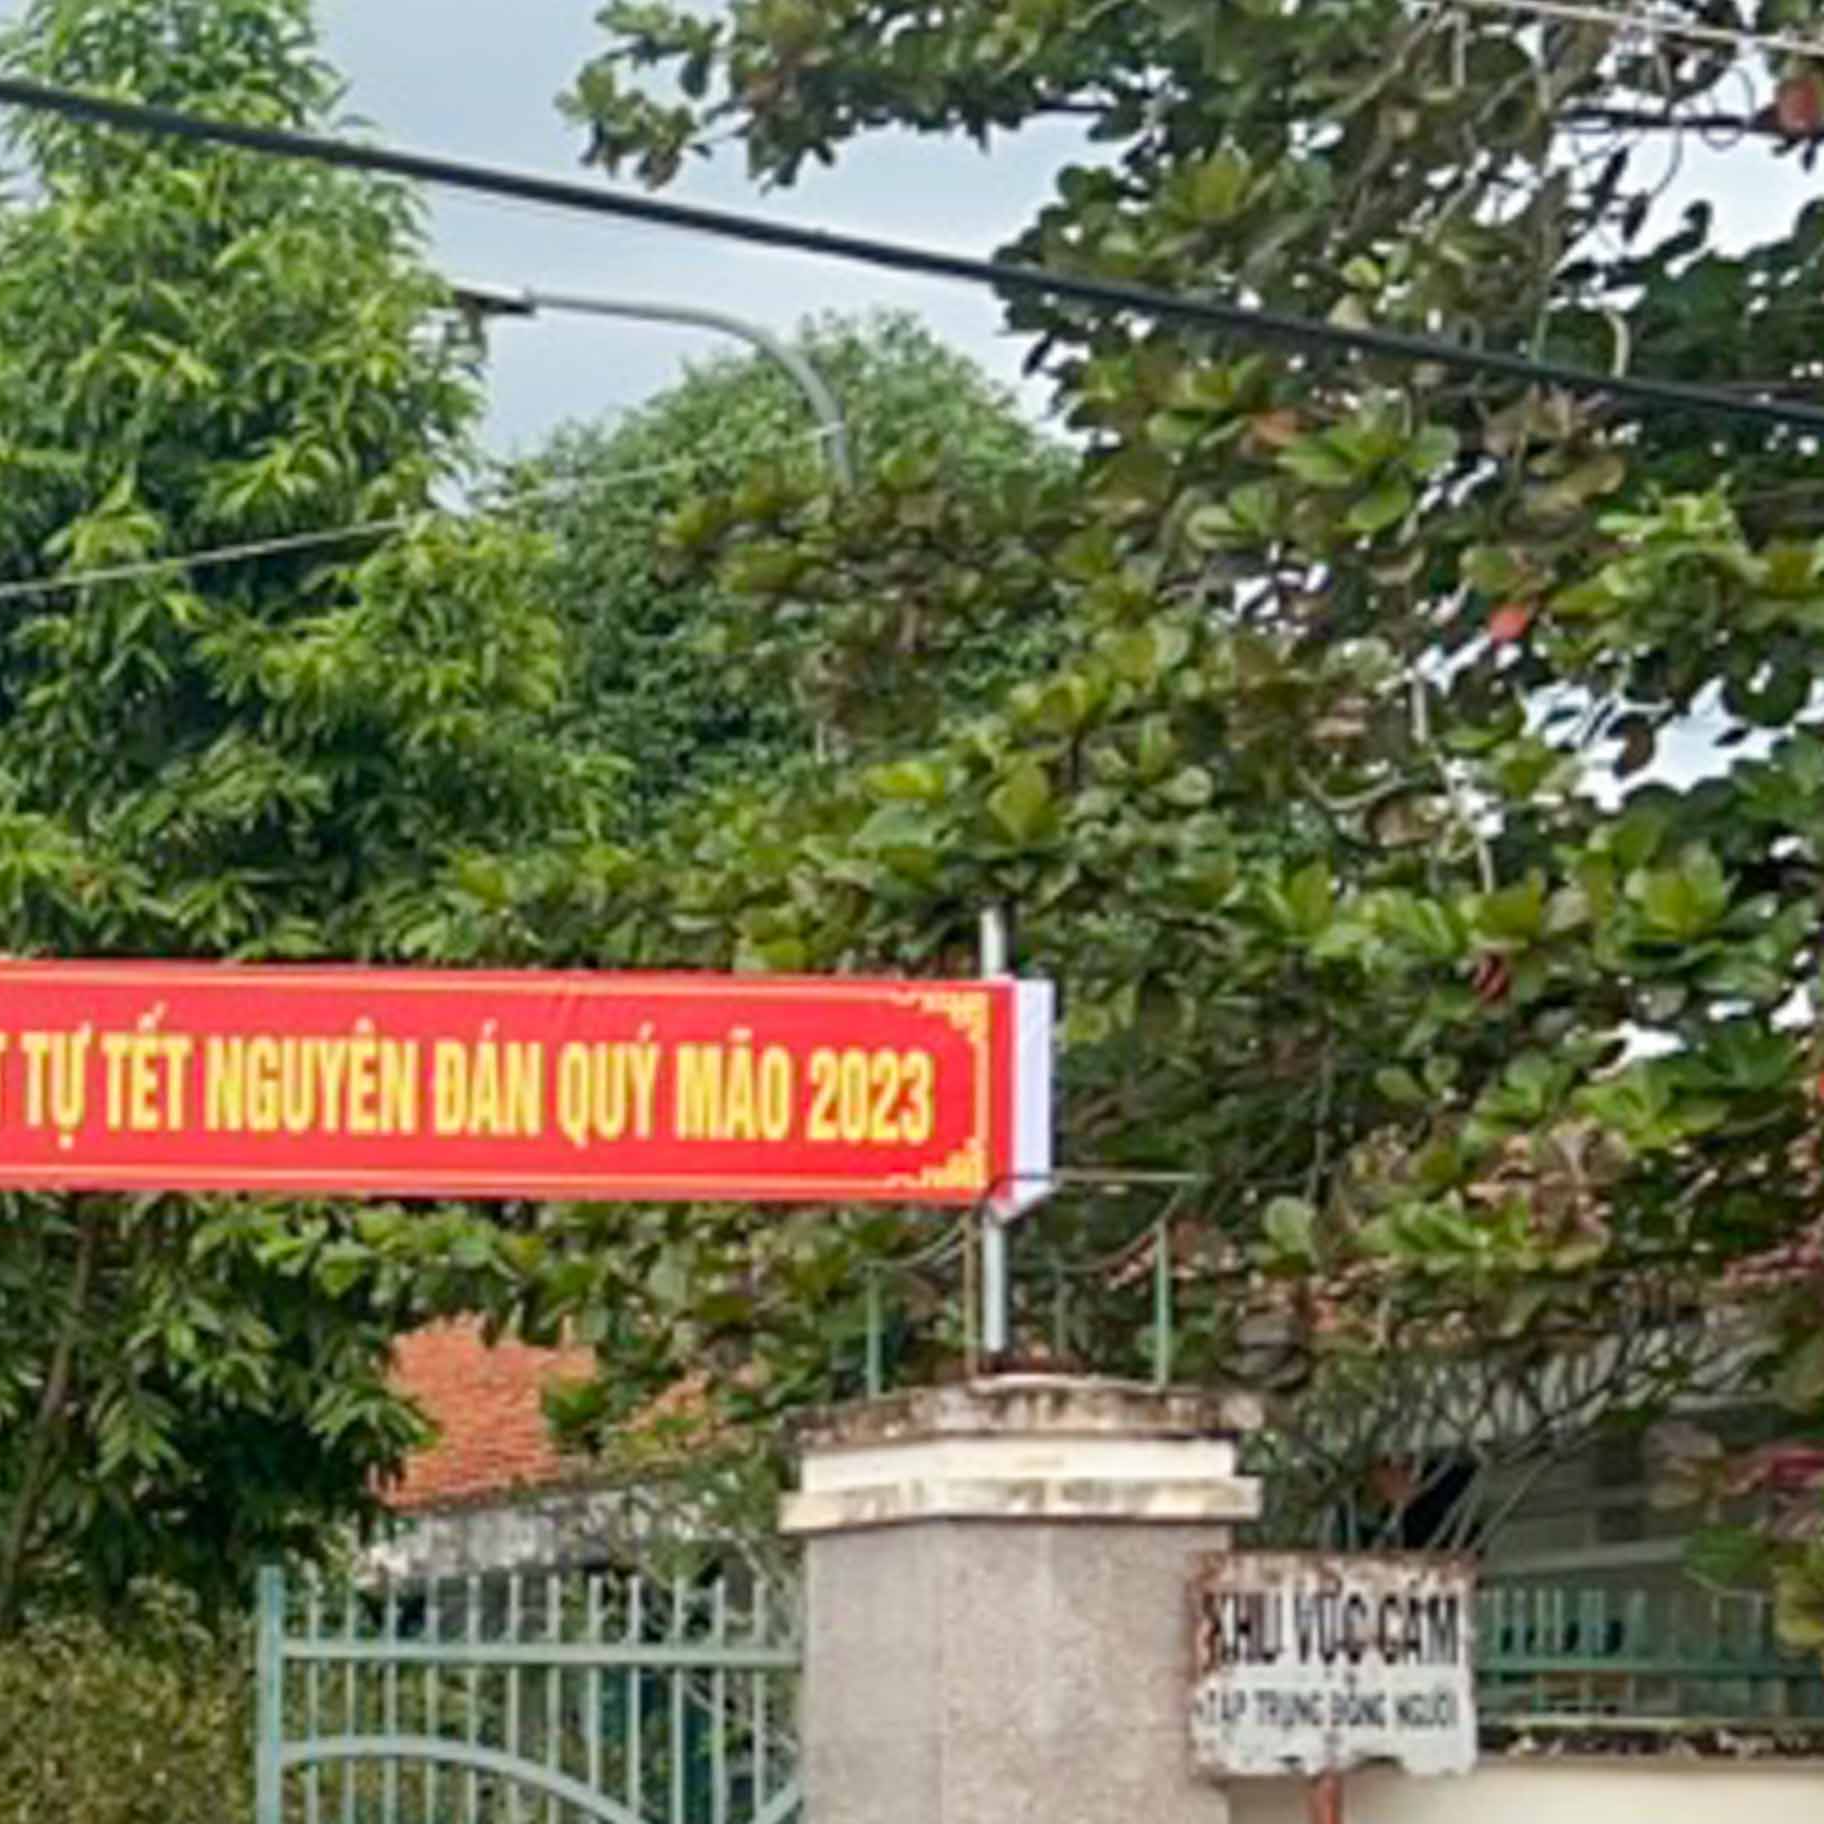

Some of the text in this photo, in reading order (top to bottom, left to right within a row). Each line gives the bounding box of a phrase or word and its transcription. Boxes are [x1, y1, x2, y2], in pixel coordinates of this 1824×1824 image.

[20, 1020, 93, 1150] TỰ
[100, 1000, 192, 1132] TẾT
[203, 1016, 417, 1135] NGUYÊN
[433, 1018, 545, 1137] ĐÁN
[557, 1021, 661, 1149] QUÝ
[675, 1025, 792, 1142] MÃO
[805, 1046, 935, 1145] 2023
[1200, 1592, 1283, 1666] KHU
